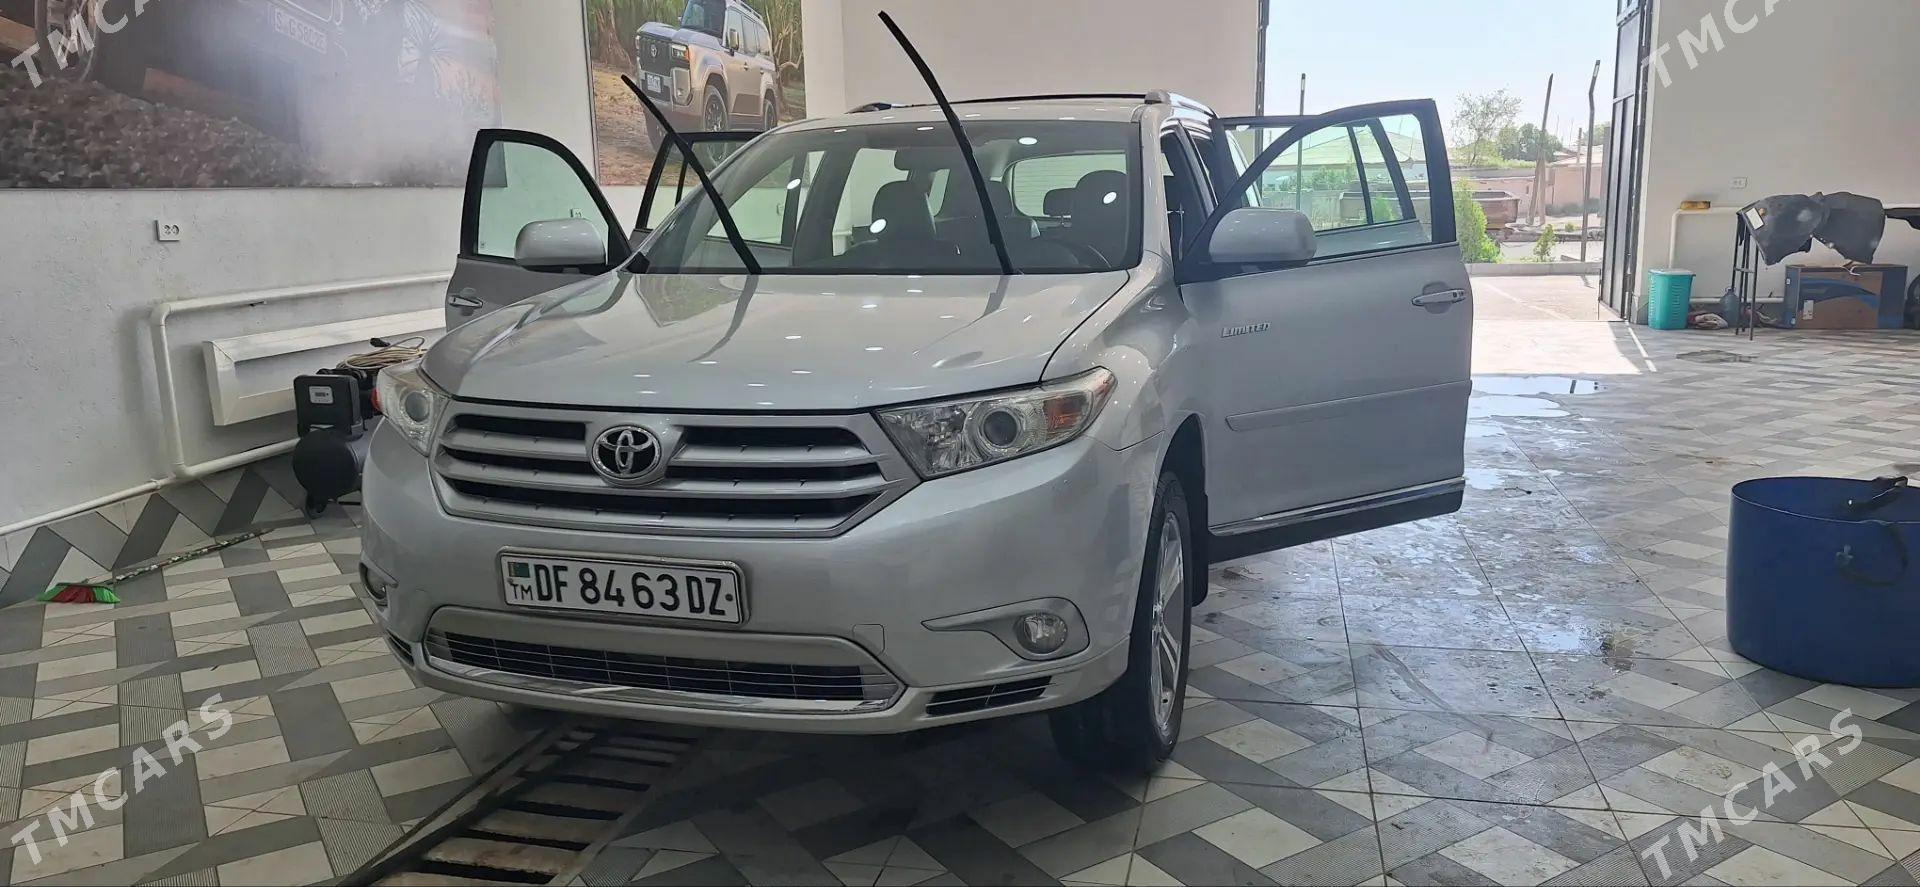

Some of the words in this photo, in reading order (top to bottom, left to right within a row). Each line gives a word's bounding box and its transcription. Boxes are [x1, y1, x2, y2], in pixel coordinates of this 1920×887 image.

[1220, 322, 1271, 338] LIMITED
[510, 583, 534, 600] TM
[534, 564, 568, 602] DF
